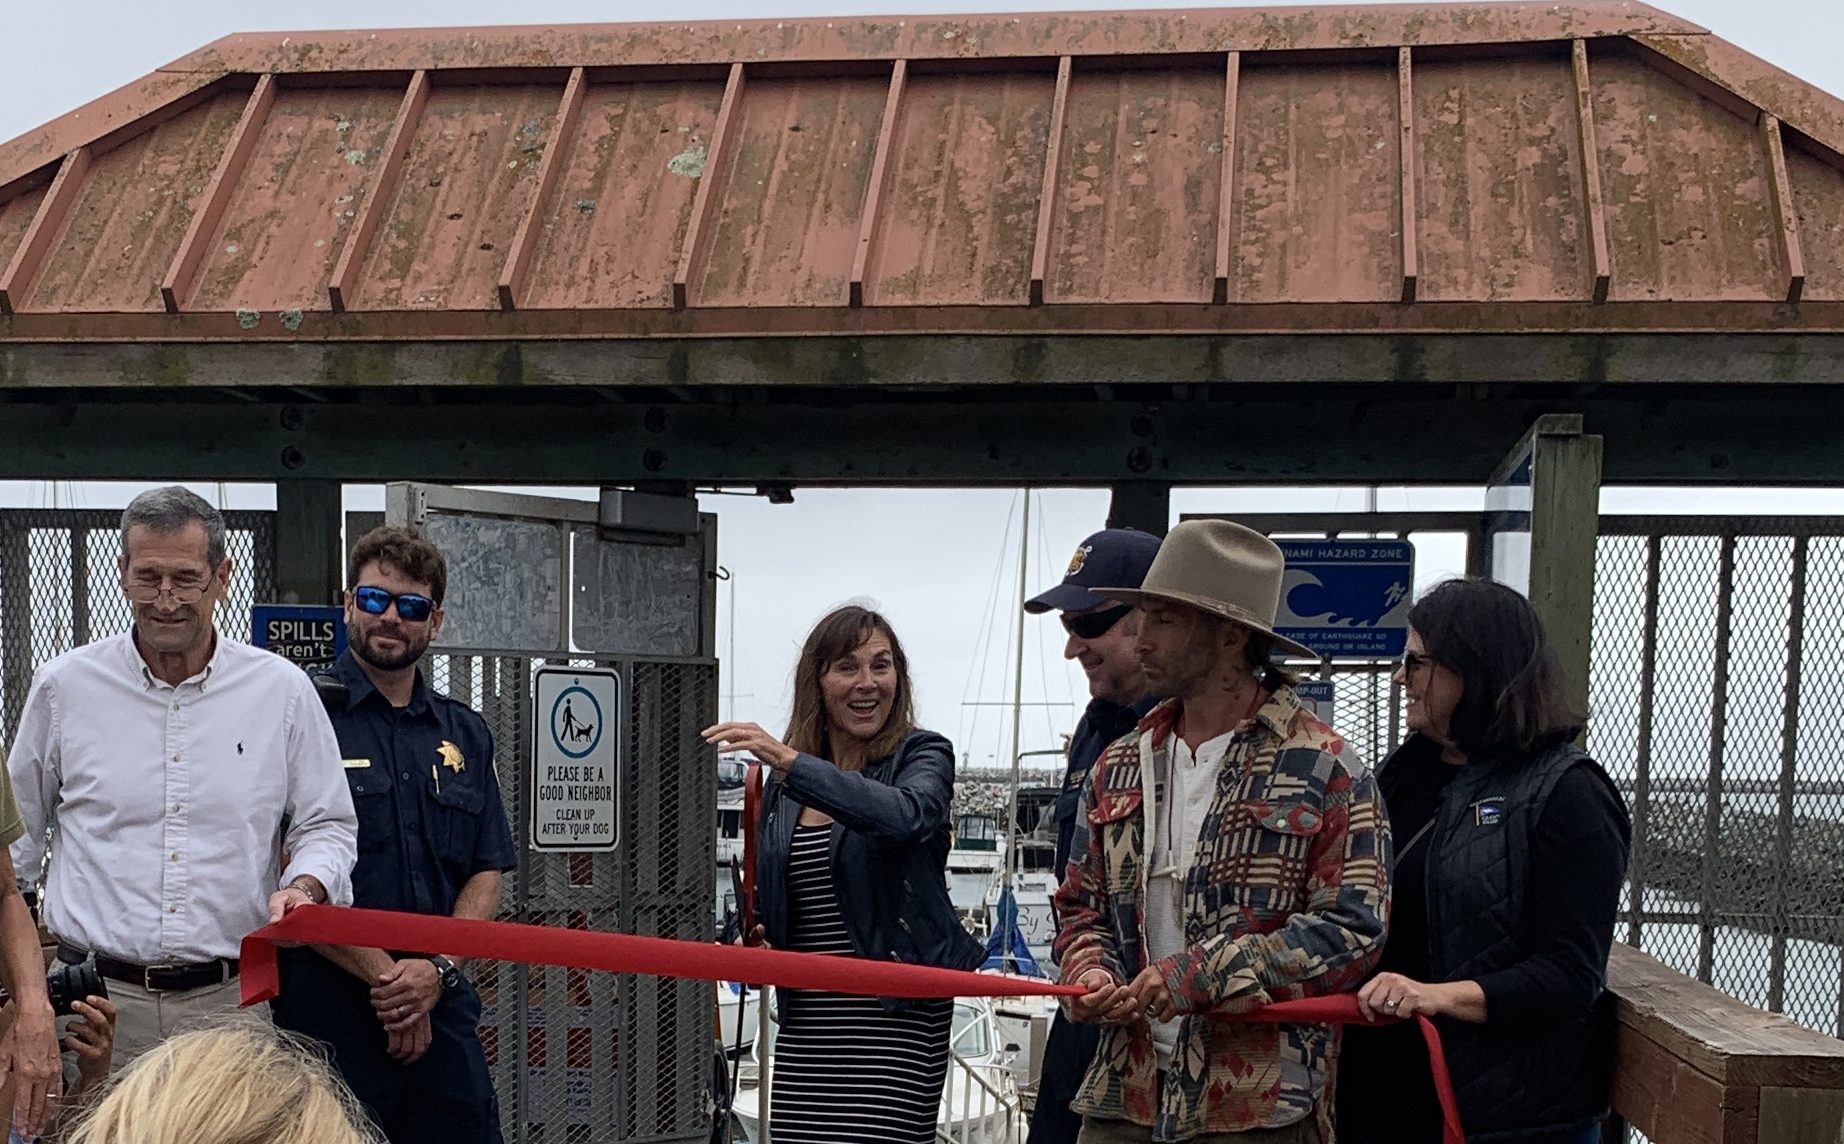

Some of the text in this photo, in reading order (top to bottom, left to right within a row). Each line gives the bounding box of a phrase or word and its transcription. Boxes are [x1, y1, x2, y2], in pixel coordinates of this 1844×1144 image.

[1285, 549, 1402, 559] NAMI HAZARD ZONE
[269, 621, 334, 641] SPILLS
[1322, 632, 1373, 640] EARTHQUAKE
[276, 642, 327, 657] aren't
[1296, 686, 1328, 696] MP-OUT
[547, 766, 604, 782] PLEASE BE A
[540, 785, 612, 801] GOOD NEIGHBOR
[556, 809, 596, 820] CLEAN UP
[541, 823, 610, 835] AFTER YOUR DOG
[1017, 906, 1038, 936] By
